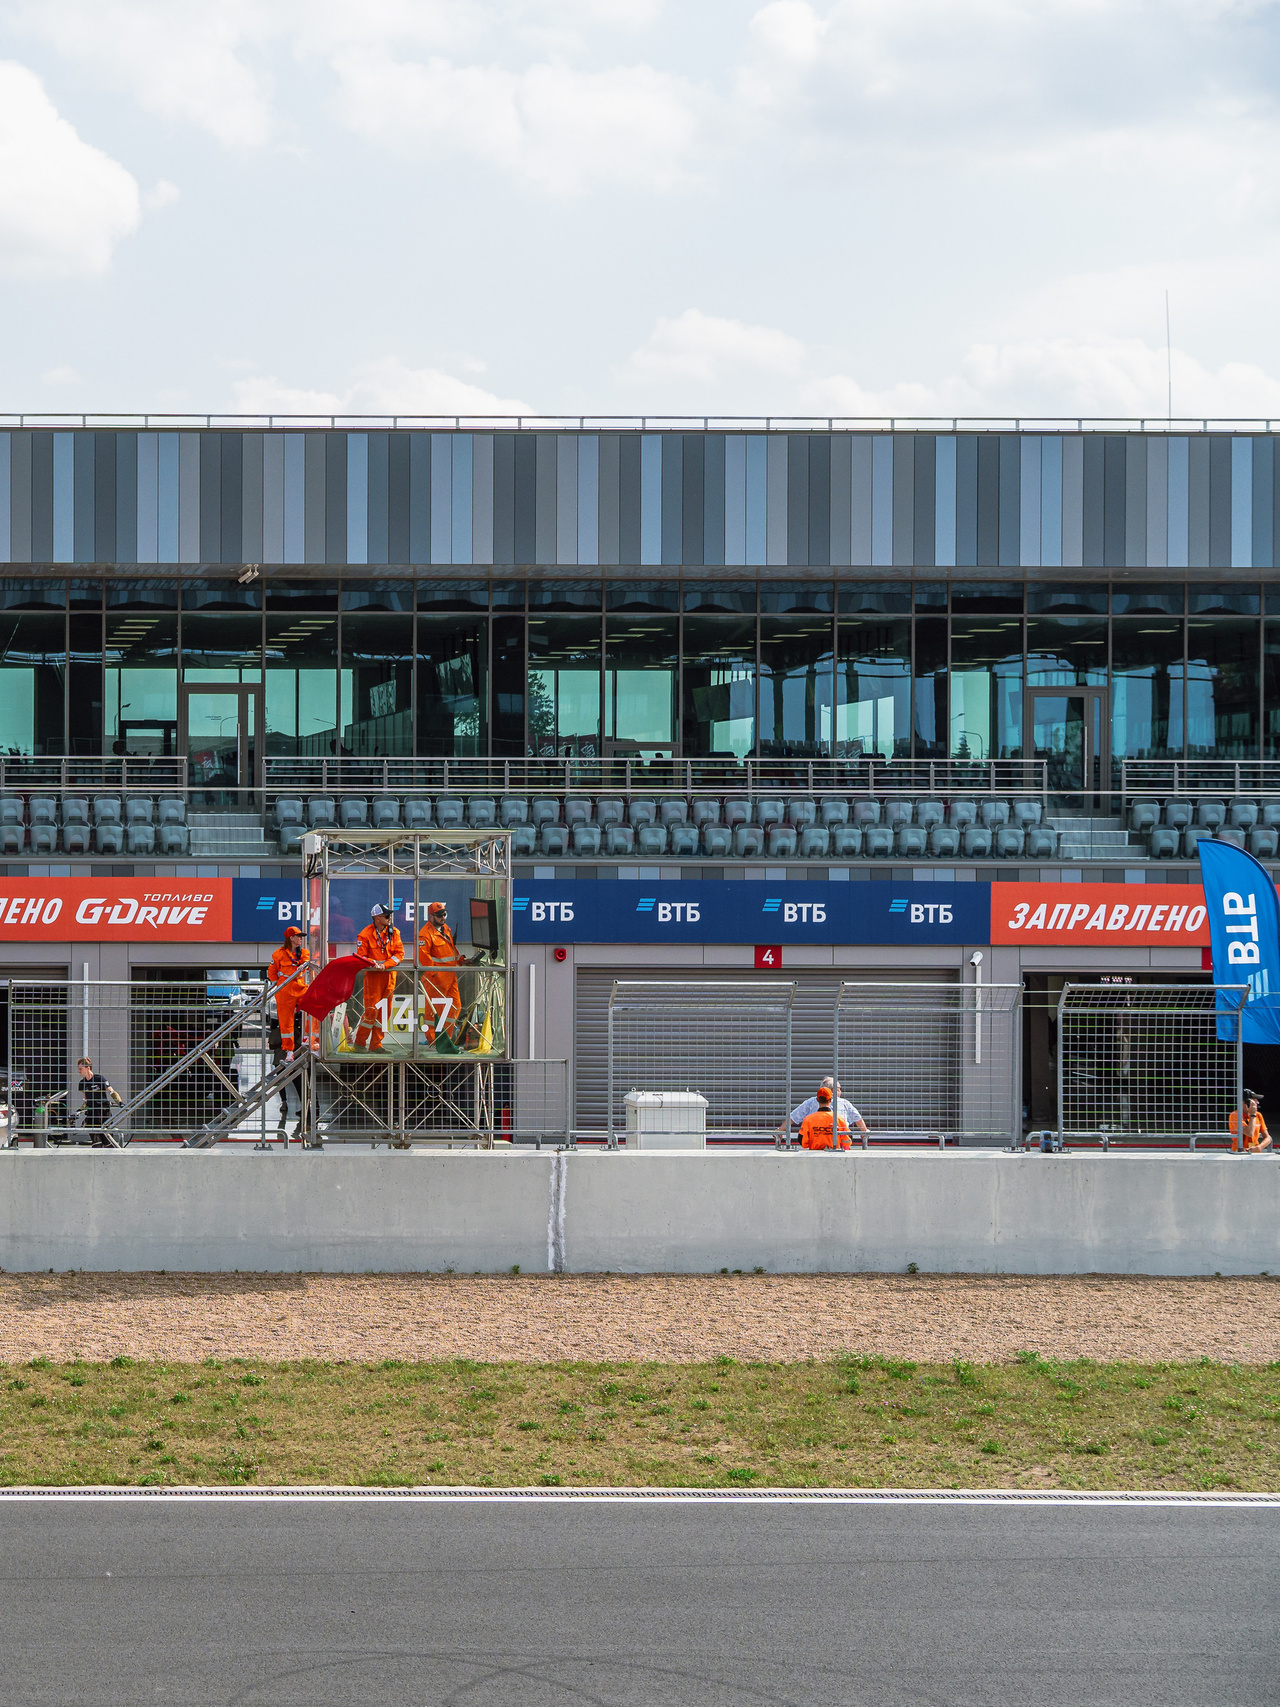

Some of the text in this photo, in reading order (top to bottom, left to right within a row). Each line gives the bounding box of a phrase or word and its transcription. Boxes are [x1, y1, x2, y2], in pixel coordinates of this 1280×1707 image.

[144, 893, 214, 902] ТОПЛИВО
[532, 902, 574, 921] ВТБ
[658, 902, 700, 922] ВТБ
[784, 903, 826, 923] ВТБ
[911, 904, 953, 924] ВТБ
[1008, 902, 1207, 931] ЗАПРАВЛЕНО
[1223, 892, 1259, 964] ВТБ
[762, 949, 774, 965] 4
[375, 998, 454, 1032] 14.7
